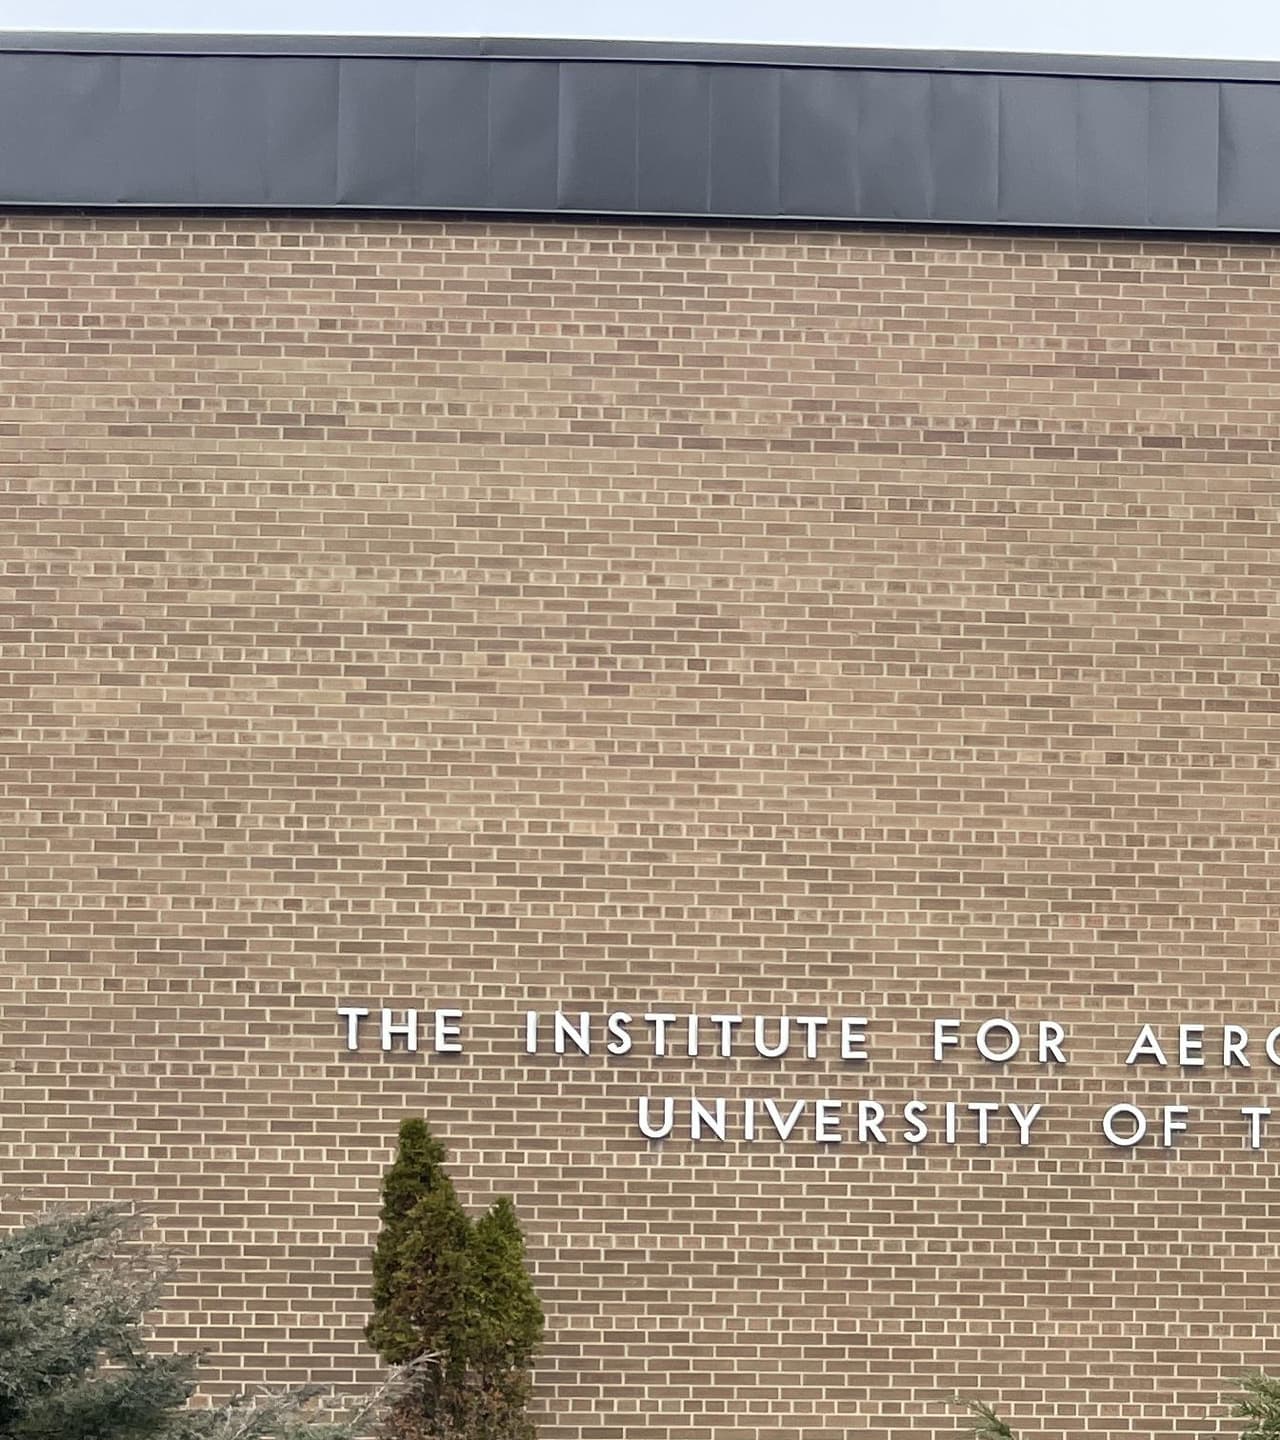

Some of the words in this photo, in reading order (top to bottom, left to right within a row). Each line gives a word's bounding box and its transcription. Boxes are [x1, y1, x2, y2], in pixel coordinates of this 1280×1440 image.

[336, 1006, 464, 1053] THE
[526, 1009, 868, 1060] INSTITUTE
[933, 1018, 1067, 1064] FOR
[638, 1096, 1043, 1146] UNIVERSITY
[1102, 1102, 1191, 1148] OF
